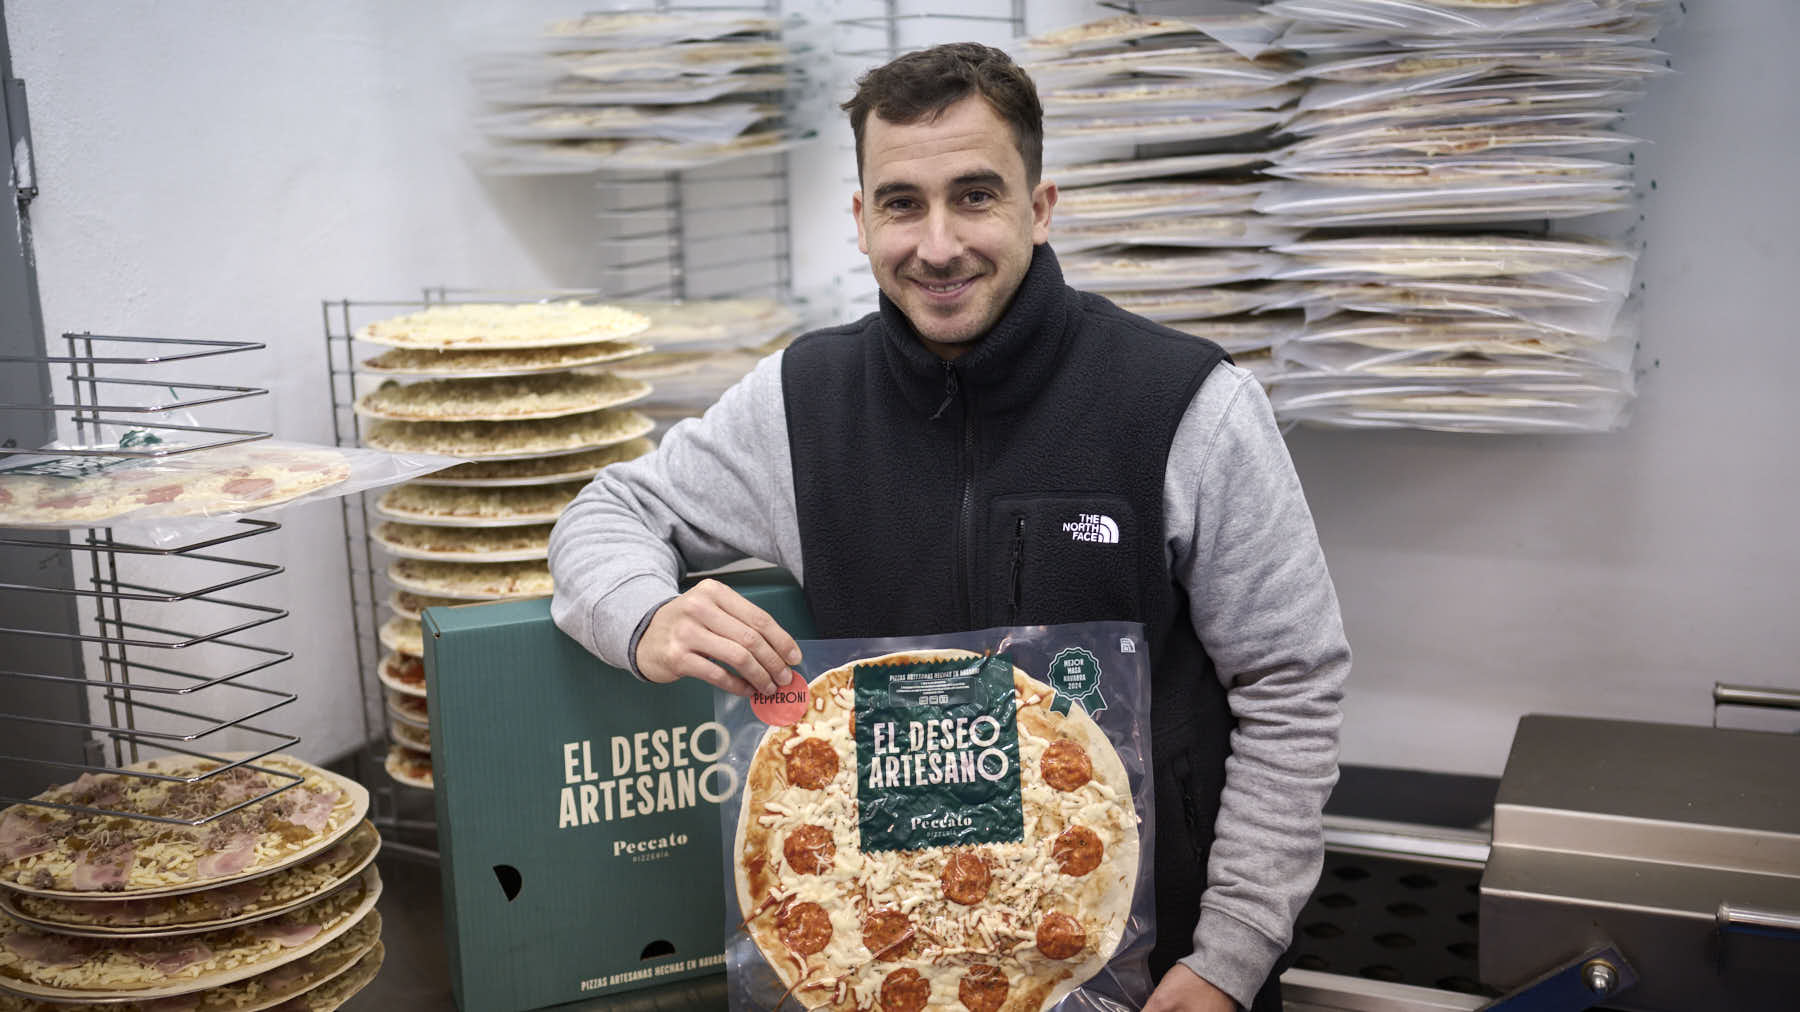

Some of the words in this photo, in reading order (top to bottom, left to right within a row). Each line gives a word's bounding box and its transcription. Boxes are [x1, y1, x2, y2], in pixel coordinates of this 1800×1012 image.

[1062, 522, 1099, 533] NORTH
[1079, 514, 1100, 524] THE
[1072, 531, 1098, 542] FACE
[753, 691, 806, 705] PEPPERONI
[873, 722, 900, 755] EL
[909, 715, 1001, 752] DESEO
[564, 740, 599, 784] EL
[611, 721, 731, 777] DESEO
[868, 748, 1010, 789] ARTESANO
[559, 763, 738, 829] ARTESANO
[911, 815, 972, 830] Peccato
[613, 832, 688, 857] Peccato
[580, 976, 608, 992] PIZZAS
[609, 967, 653, 986] ARTESANAS
[654, 961, 685, 977] HECHAS
[686, 959, 697, 970] EN
